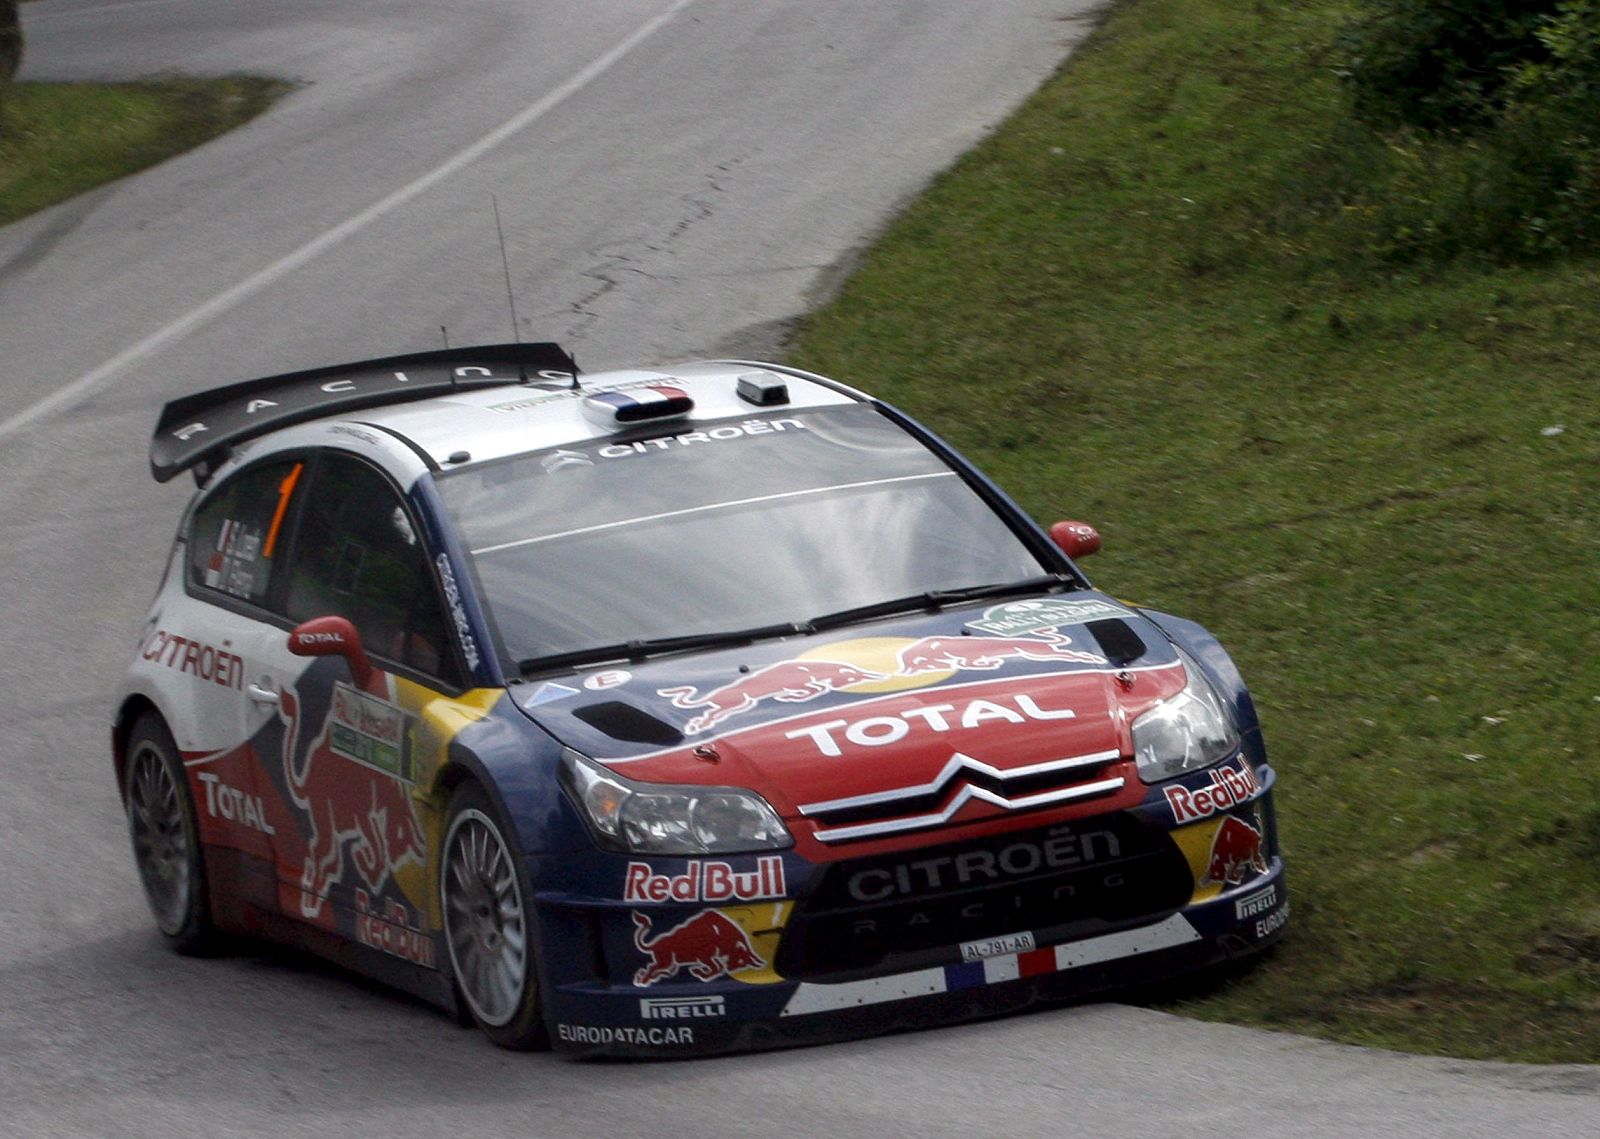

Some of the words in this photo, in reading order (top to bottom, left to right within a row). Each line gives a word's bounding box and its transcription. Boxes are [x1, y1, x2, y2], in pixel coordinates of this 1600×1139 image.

[262, 462, 304, 558] 1
[297, 632, 344, 645] TOTAL
[784, 694, 1077, 758] TOTAL
[197, 771, 277, 836] TOTAL
[1162, 768, 1235, 825] Red
[624, 859, 701, 901] Red
[702, 856, 787, 901] Bull
[1234, 884, 1278, 920] PIRELLI
[967, 934, 1032, 958] AL-791-AR
[640, 995, 727, 1019] PIRELLI
[557, 1023, 694, 1045] EURODATACAR
